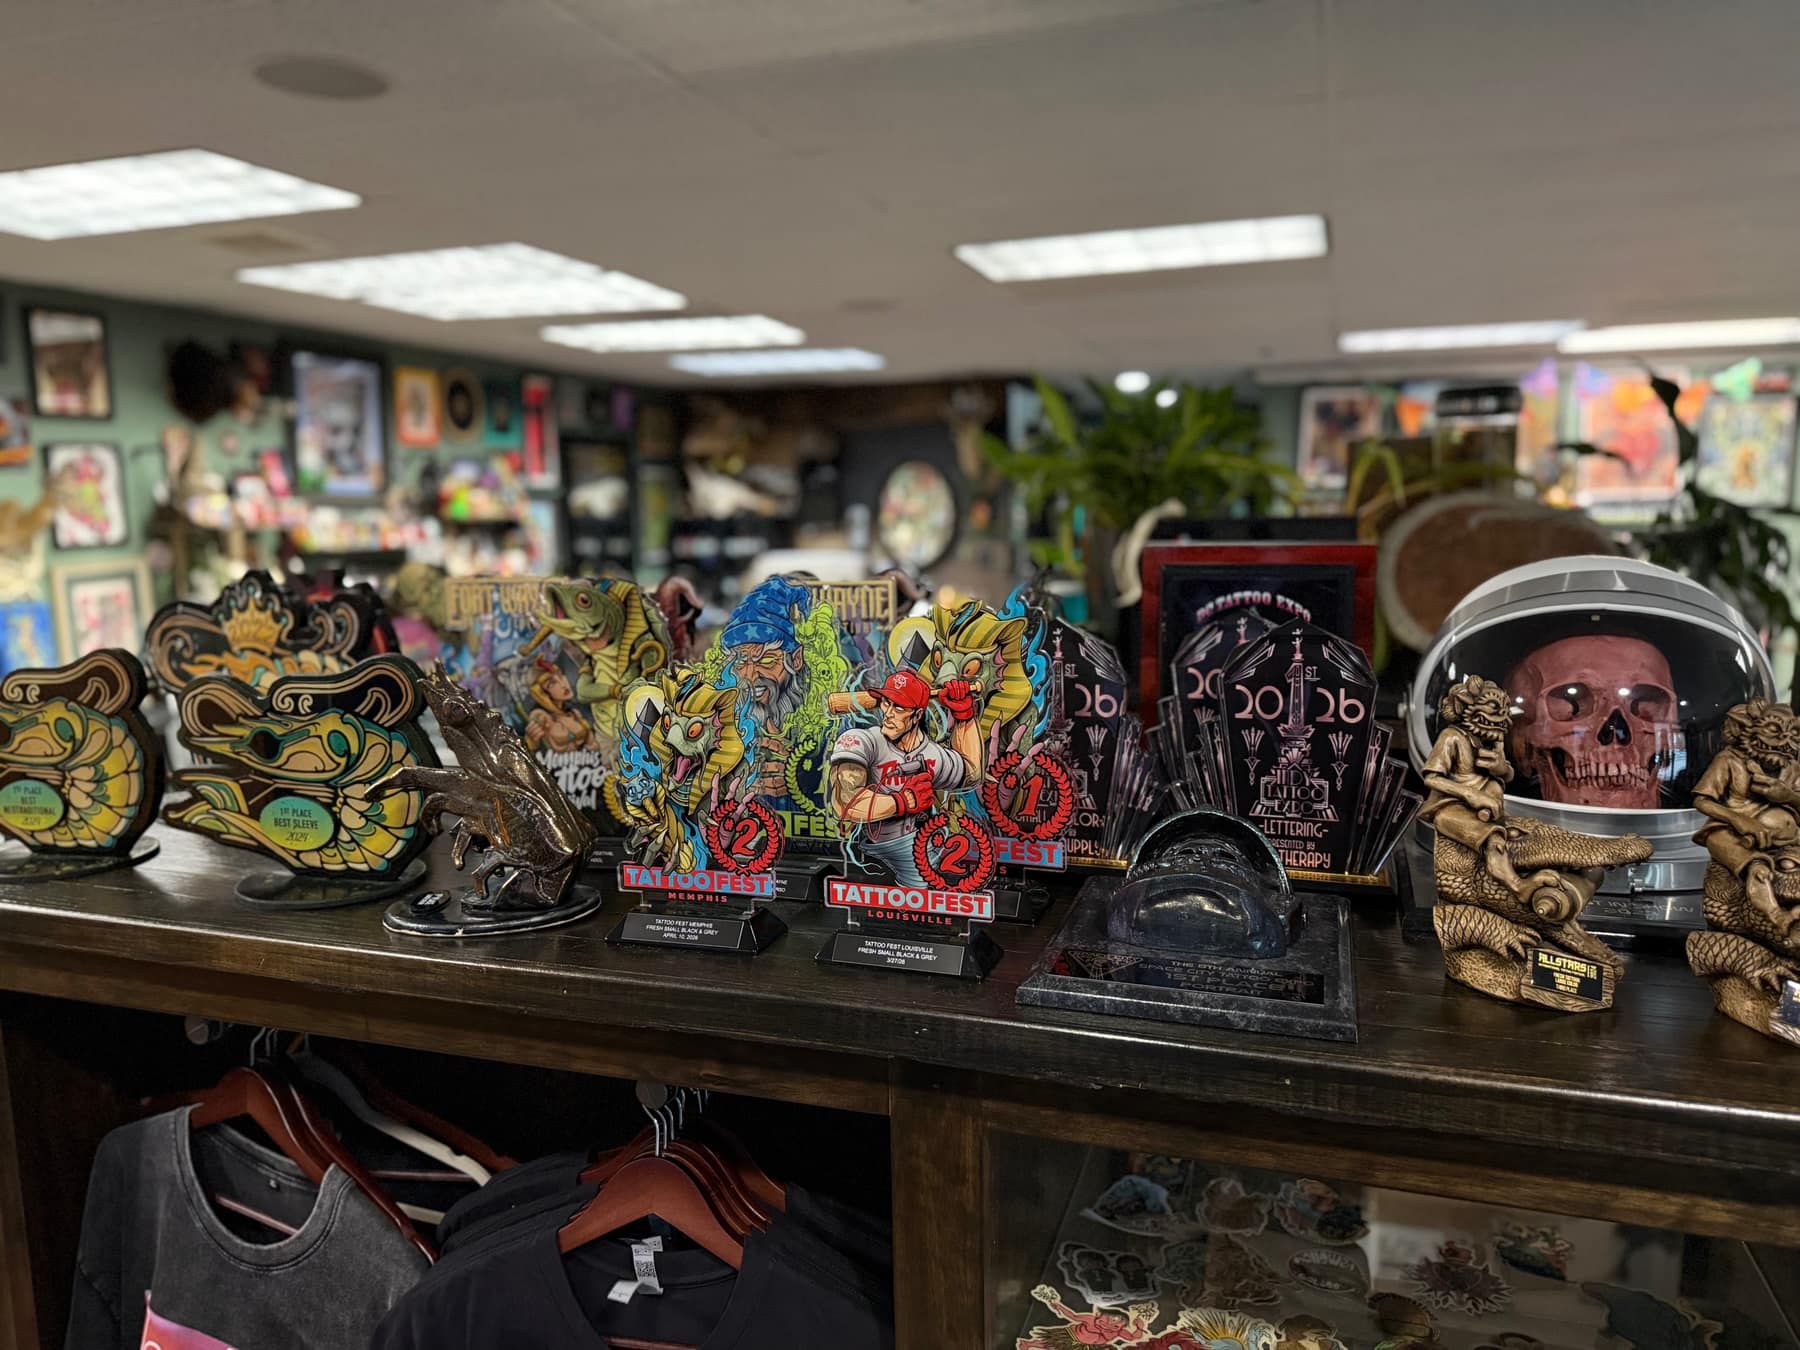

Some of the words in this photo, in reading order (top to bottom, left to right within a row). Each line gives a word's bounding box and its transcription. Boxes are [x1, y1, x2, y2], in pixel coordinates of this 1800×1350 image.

[1215, 590, 1272, 611] TATTOO
[1074, 683, 1118, 718] 26
[1234, 684, 1284, 720] 20
[1315, 687, 1366, 723] 26
[1266, 784, 1326, 801] TATTOO
[292, 808, 313, 818] PLACE
[274, 817, 291, 828] BEST
[293, 819, 320, 829] SLEEVE
[1279, 850, 1332, 869] THERAPY
[626, 868, 711, 889] TATTOO
[716, 873, 771, 894] FEST
[668, 892, 728, 903] MEMPHIS
[833, 883, 925, 908] TATTOO
[930, 893, 991, 915] FEST
[655, 918, 675, 926] TATTOO
[867, 909, 953, 925] LOUISVILLE
[865, 940, 886, 948] TATTOO
[901, 944, 934, 954] LOUISVILLE
[896, 951, 915, 959] BLACK
[1186, 968, 1216, 977] CITY
